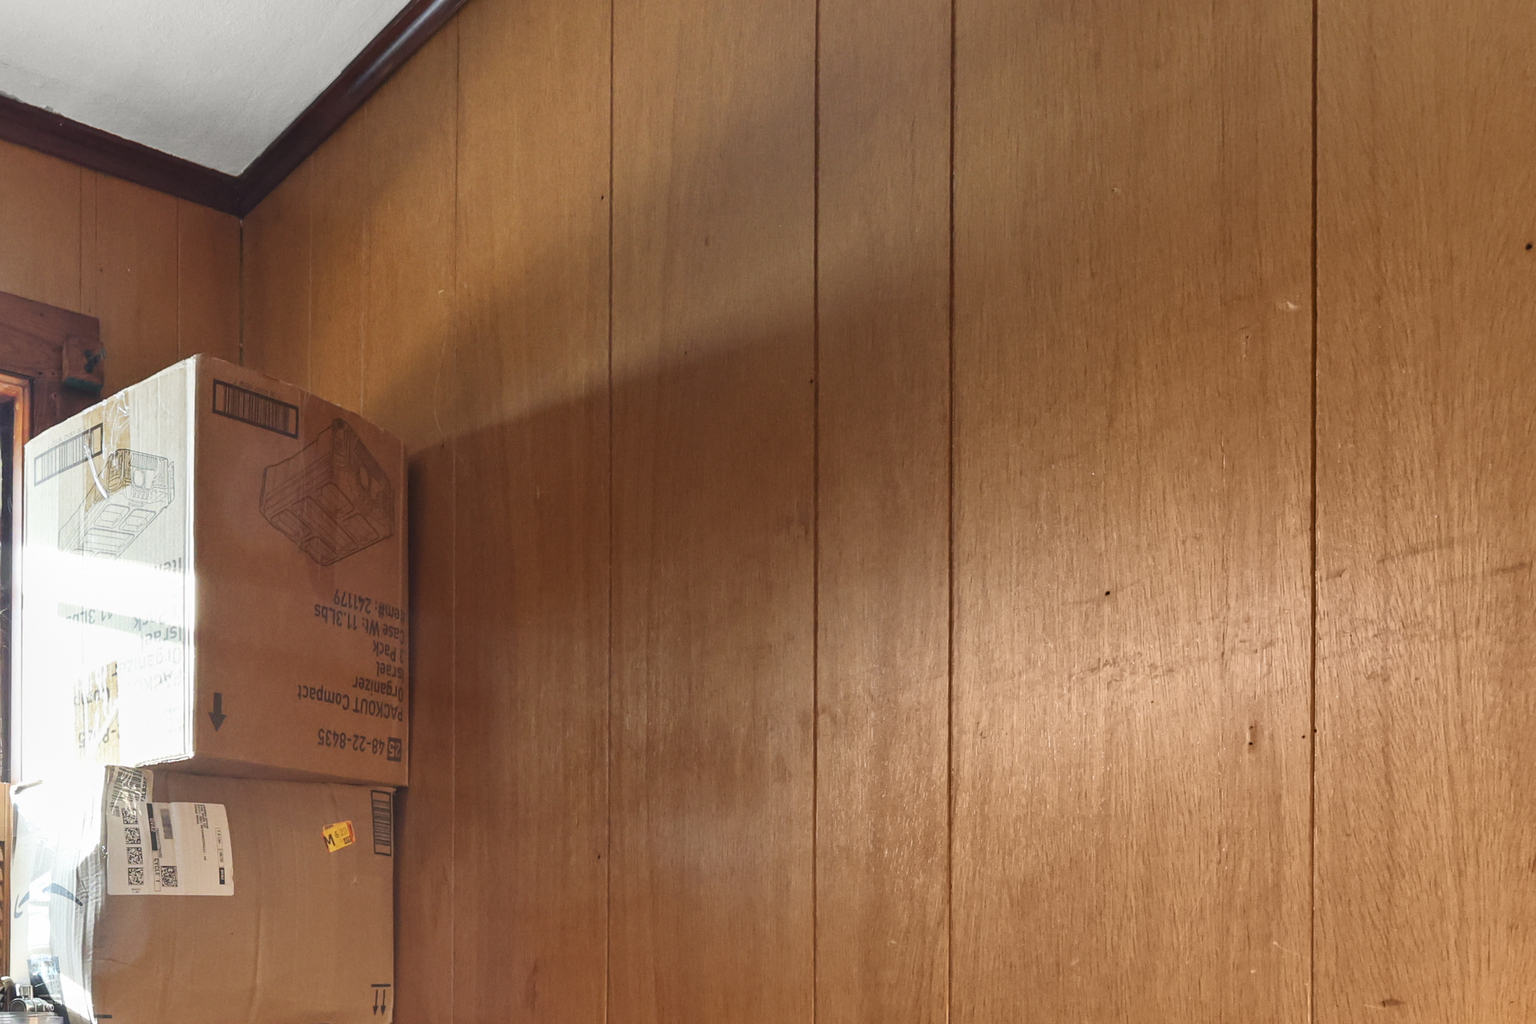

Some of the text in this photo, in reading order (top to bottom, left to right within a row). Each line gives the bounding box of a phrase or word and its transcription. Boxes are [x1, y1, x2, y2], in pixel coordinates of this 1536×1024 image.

[332, 589, 372, 614] 241179
[313, 604, 358, 631] 11.3Lbs
[382, 623, 404, 645] Case
[372, 640, 397, 662] Pack
[376, 661, 404, 684] Israel
[352, 676, 404, 702] Organizer
[296, 684, 403, 722] PACKOUT Compact
[317, 728, 402, 760] 25 48-22-8435
